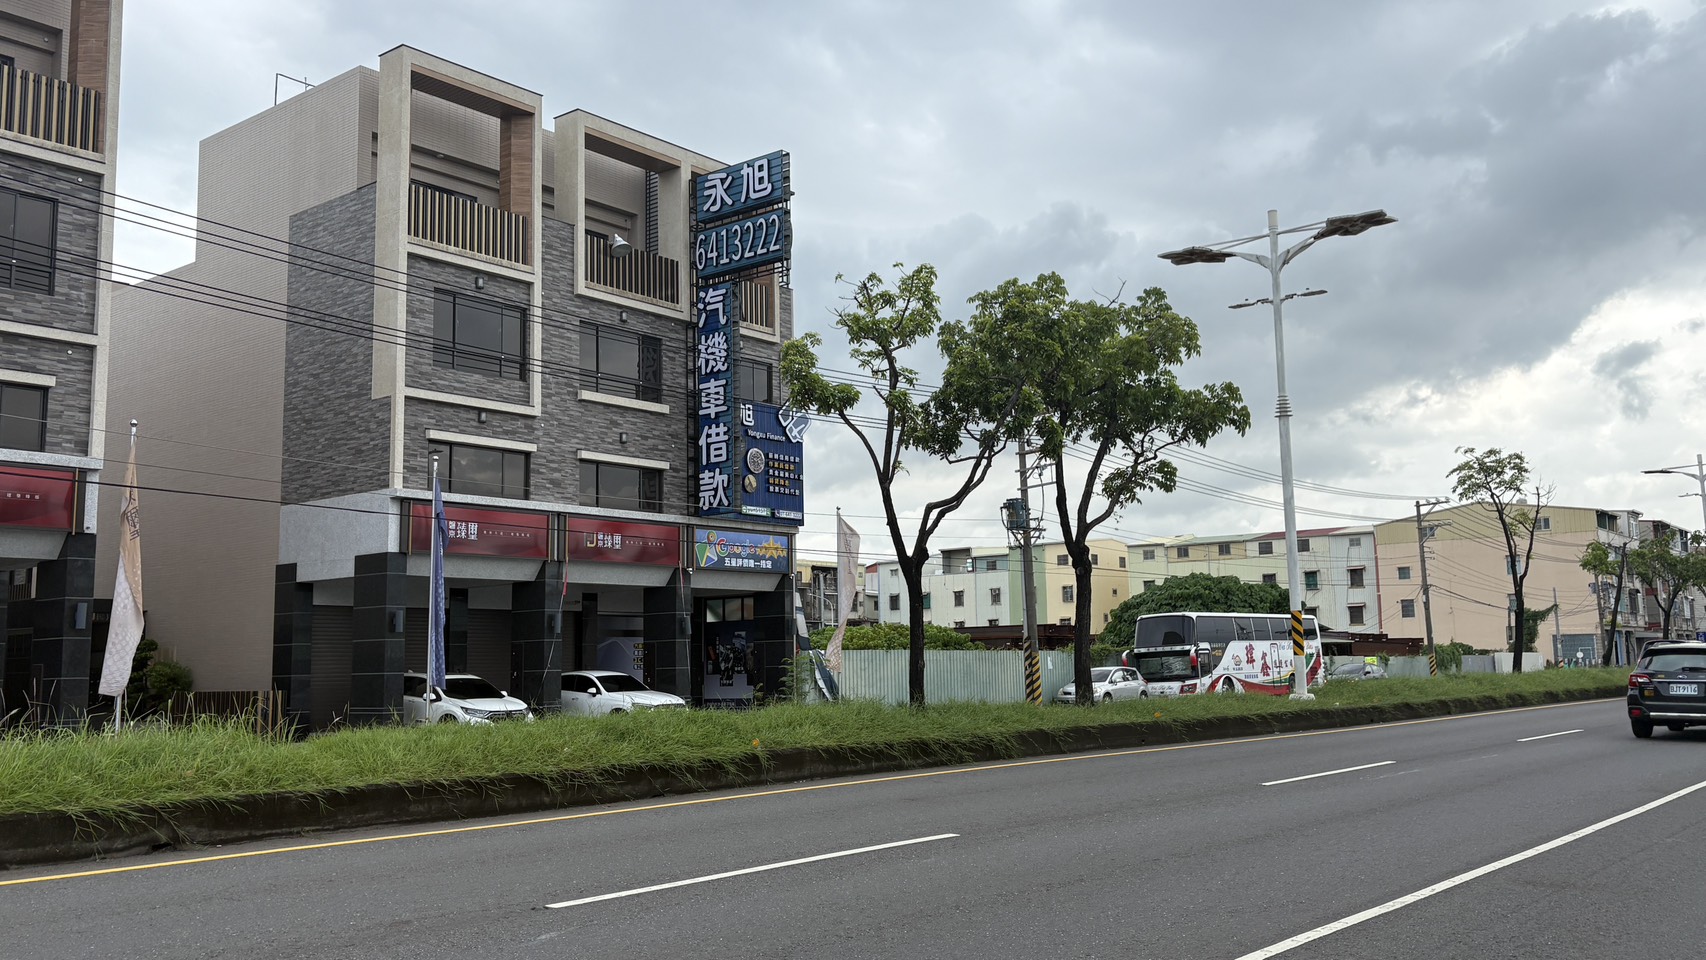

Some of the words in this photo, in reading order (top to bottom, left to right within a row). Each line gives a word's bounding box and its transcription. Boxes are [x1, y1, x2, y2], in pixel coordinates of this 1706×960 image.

[703, 158, 773, 212] 永旭
[696, 214, 780, 270] 6413222
[698, 288, 729, 511] 汽機車借款
[767, 432, 786, 442] Finance
[716, 538, 756, 557] Google
